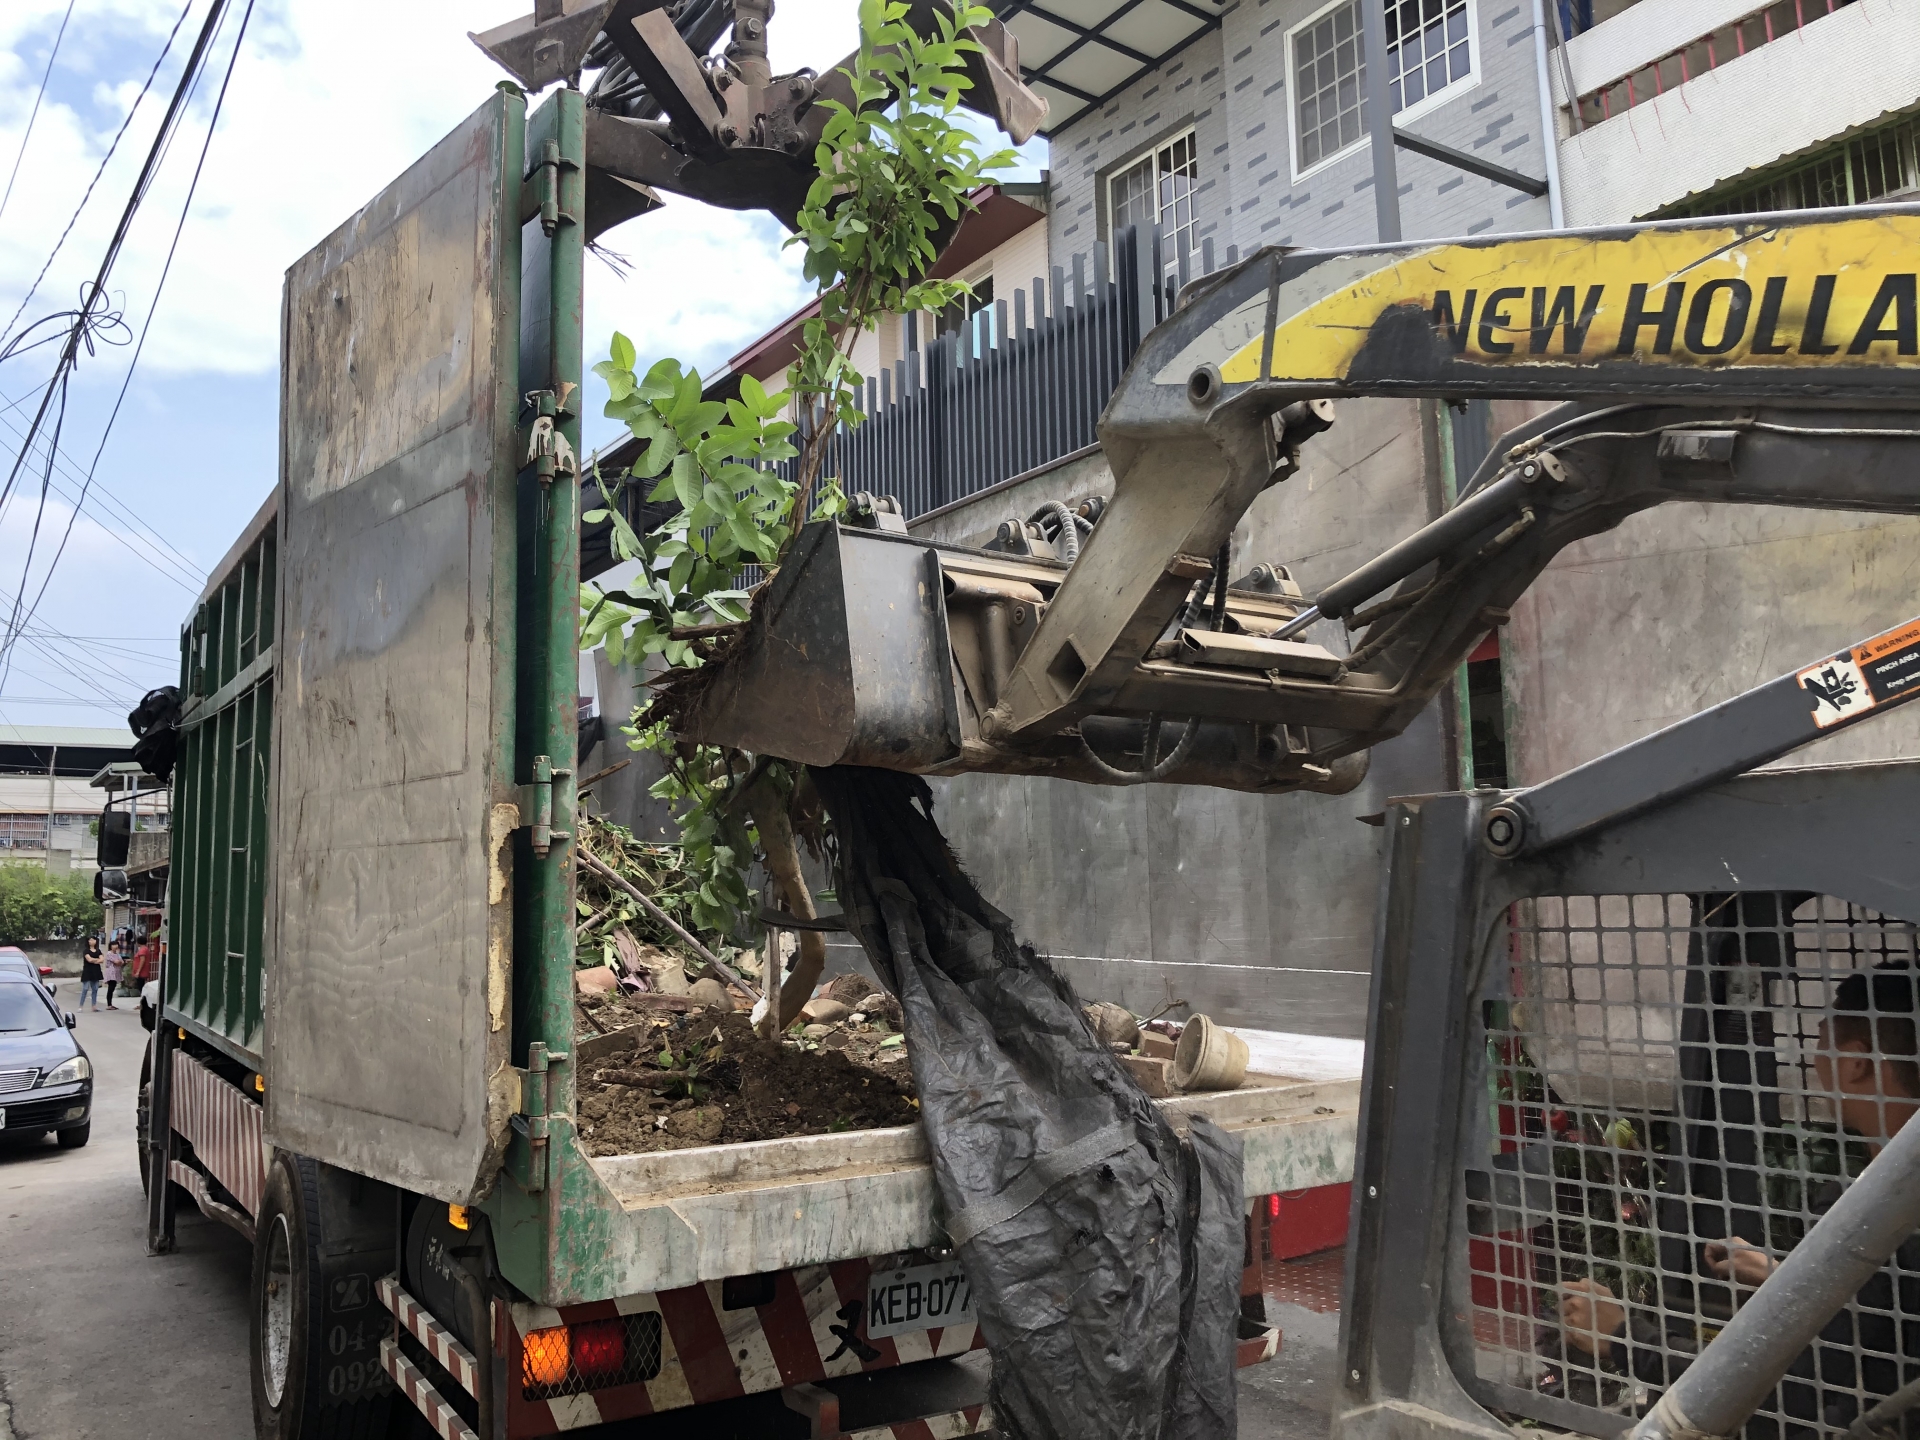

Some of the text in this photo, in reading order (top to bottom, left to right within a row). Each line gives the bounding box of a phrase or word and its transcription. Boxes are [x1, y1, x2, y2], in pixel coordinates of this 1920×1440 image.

[1433, 272, 1919, 356] NEW HOLLA
[1874, 629, 1920, 652] WARNING
[1875, 652, 1919, 674] PINCH AREA
